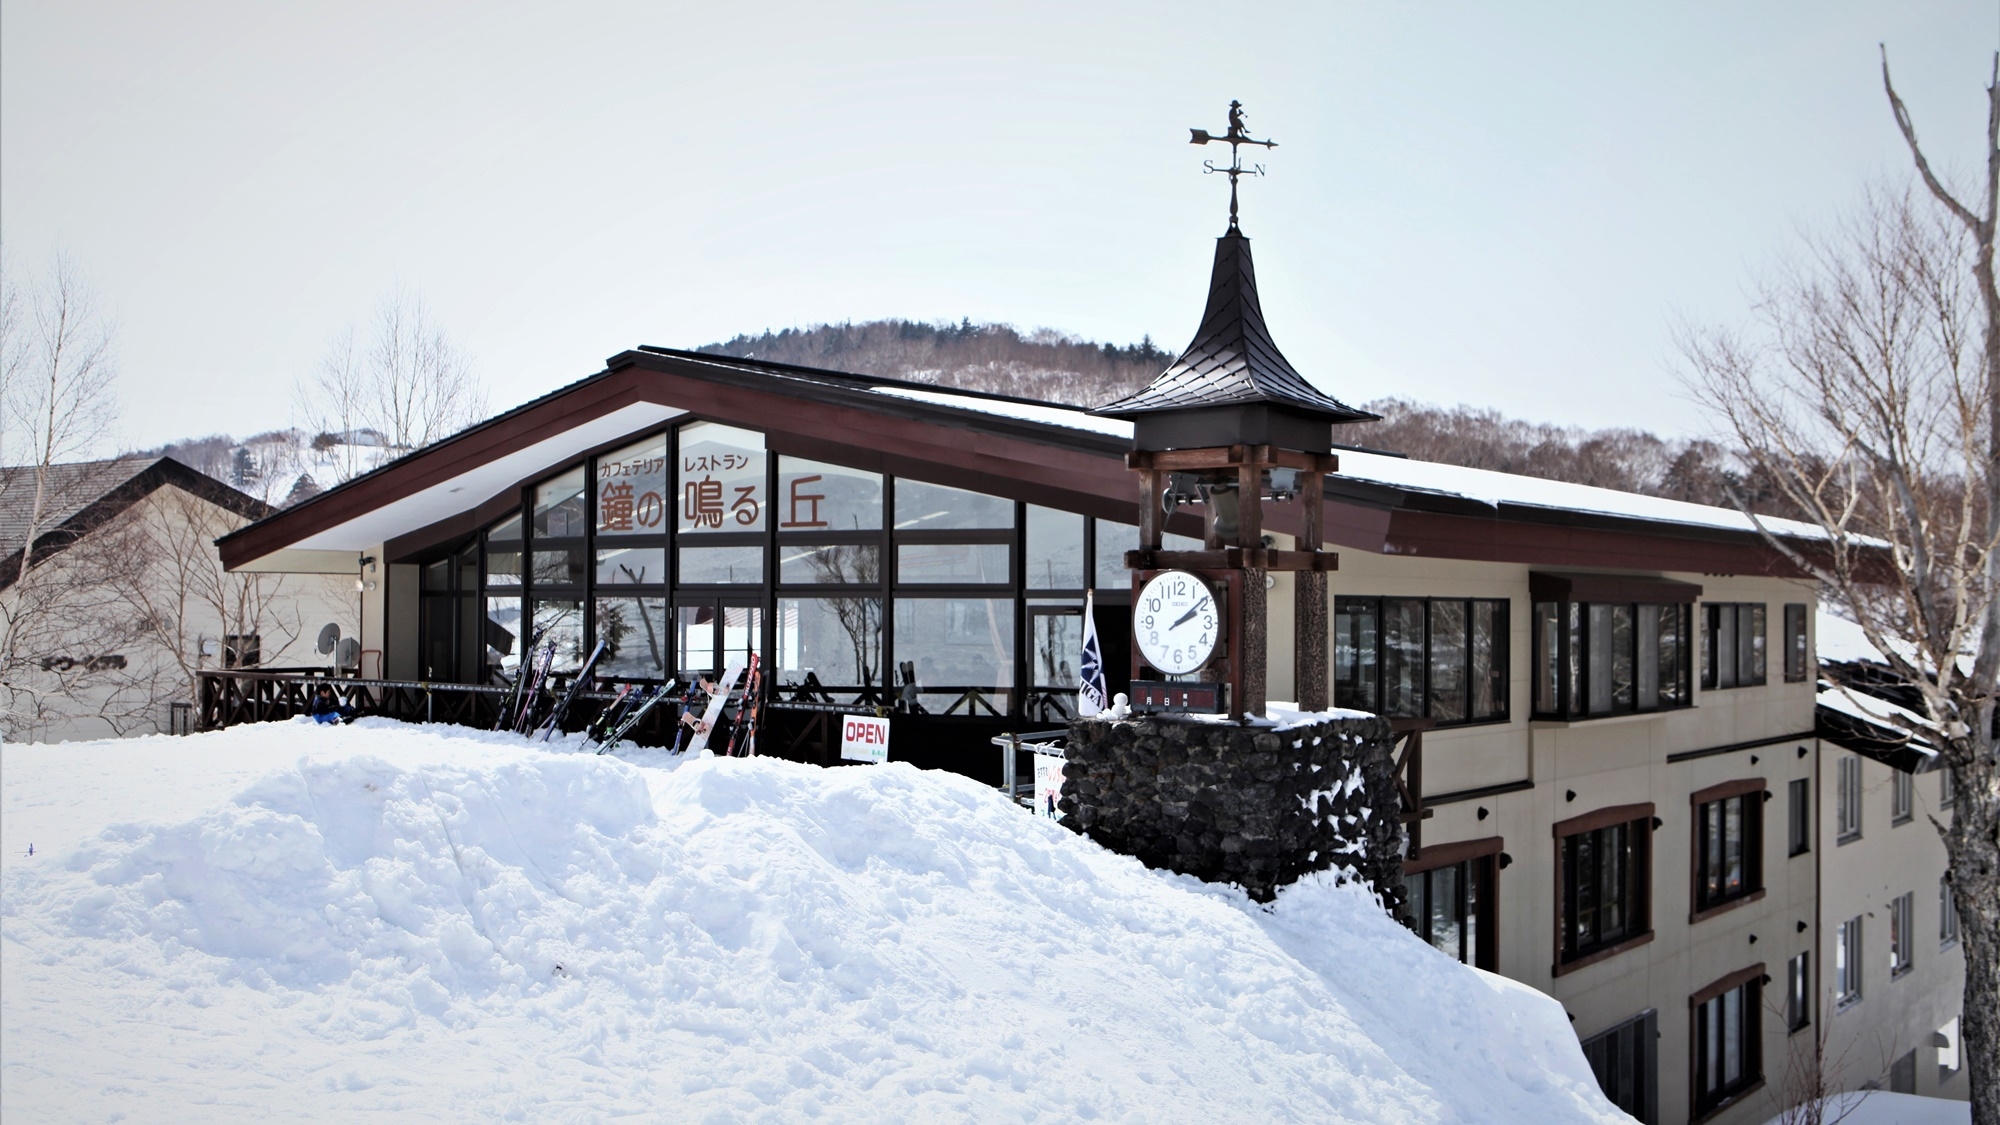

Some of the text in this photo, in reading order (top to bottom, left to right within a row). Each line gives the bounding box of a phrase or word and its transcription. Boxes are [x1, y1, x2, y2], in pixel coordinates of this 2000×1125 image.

[1203, 160, 1214, 174] S
[1254, 163, 1266, 177] N
[601, 458, 664, 478] カフェテリア
[684, 454, 749, 473] レストラン
[1173, 581, 1186, 596] 12
[1148, 598, 1161, 613] 10
[845, 722, 886, 745] OPEN
